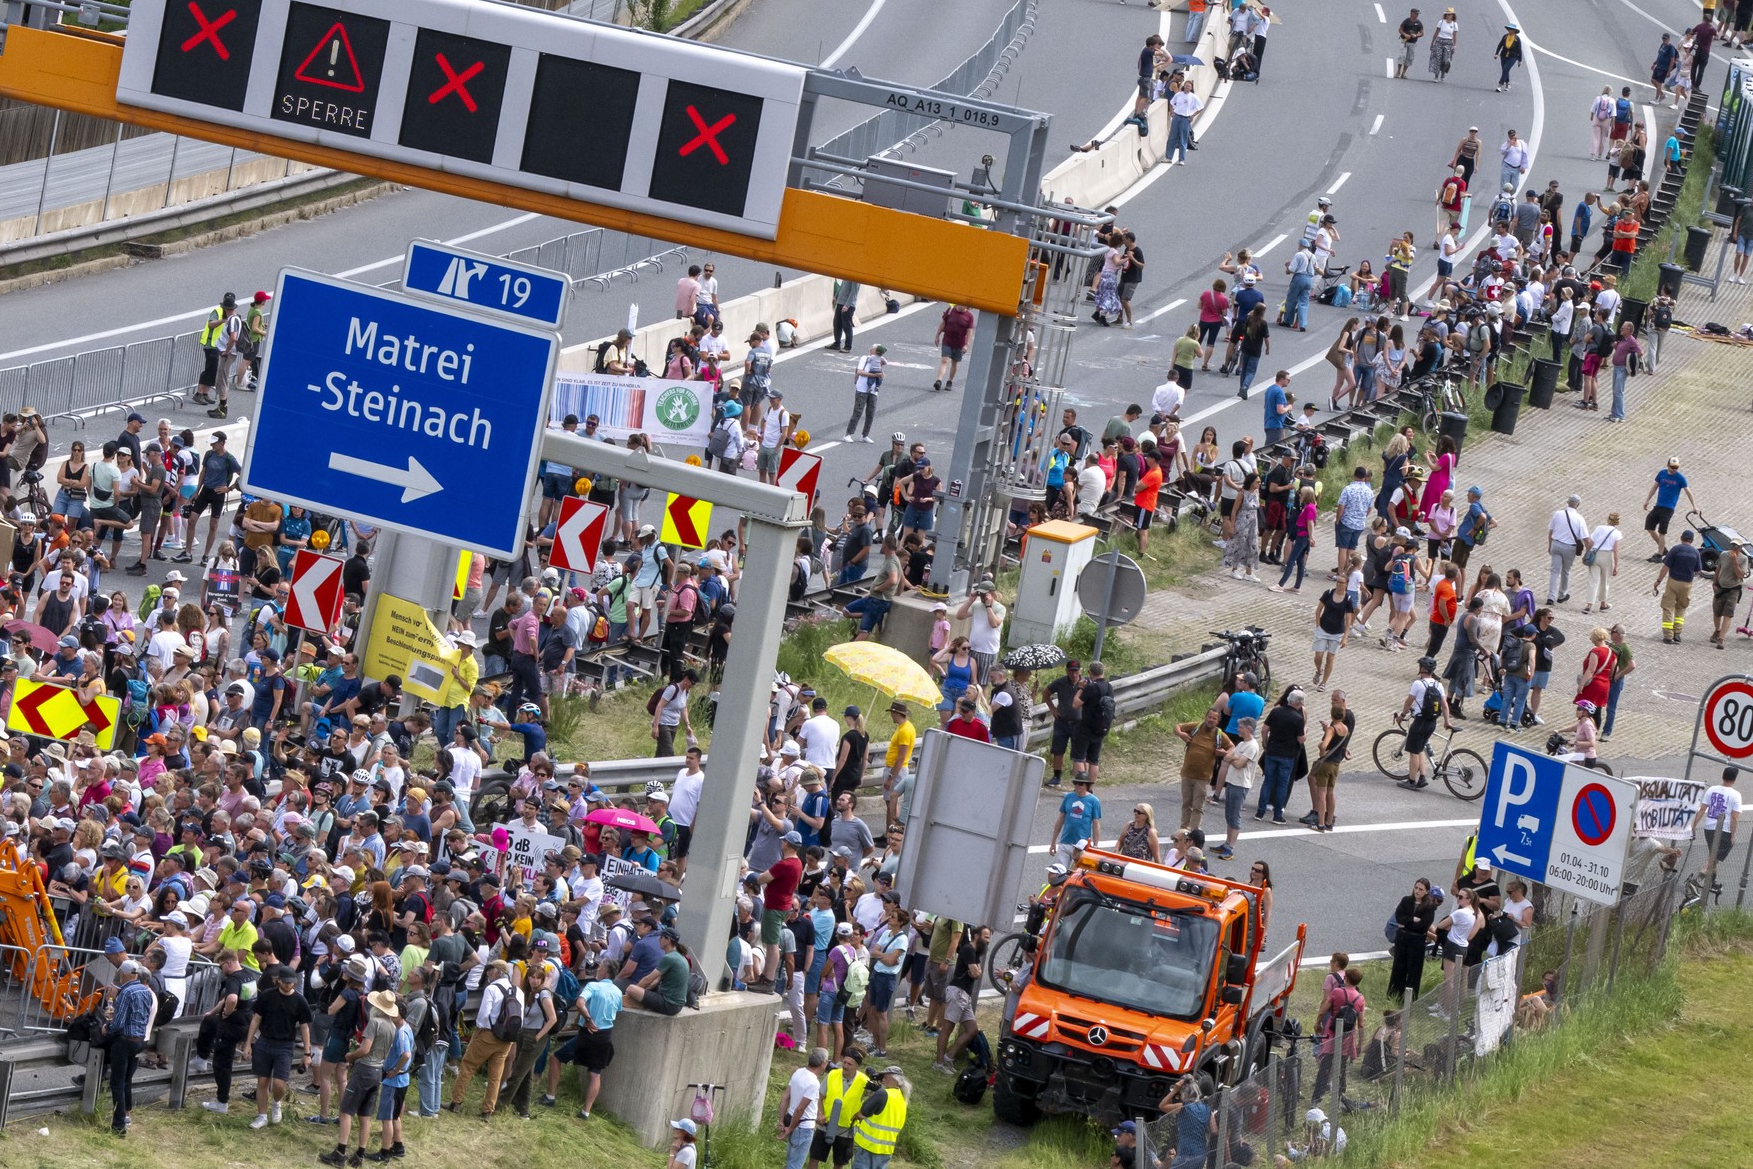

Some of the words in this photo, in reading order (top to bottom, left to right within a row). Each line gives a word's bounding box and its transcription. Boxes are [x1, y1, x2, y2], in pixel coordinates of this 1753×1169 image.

[281, 94, 368, 130] SPERRE
[886, 93, 1000, 127] AQ_A13_1_018,9
[498, 273, 532, 308] 19
[345, 316, 475, 385] Matrei
[657, 387, 676, 407] TEACHERS
[685, 390, 699, 407] FUTURE
[307, 371, 492, 450] -Steinach
[390, 609, 412, 625] Mensch
[391, 624, 405, 636] NEIN
[405, 630, 416, 640] zum
[1718, 698, 1753, 743] 80
[1495, 751, 1537, 829] P
[616, 816, 636, 826] NEOS
[514, 837, 531, 853] dB
[1520, 831, 1533, 847] 7,5t
[514, 853, 535, 867] KEIN
[1599, 882, 1616, 897] Uhr
